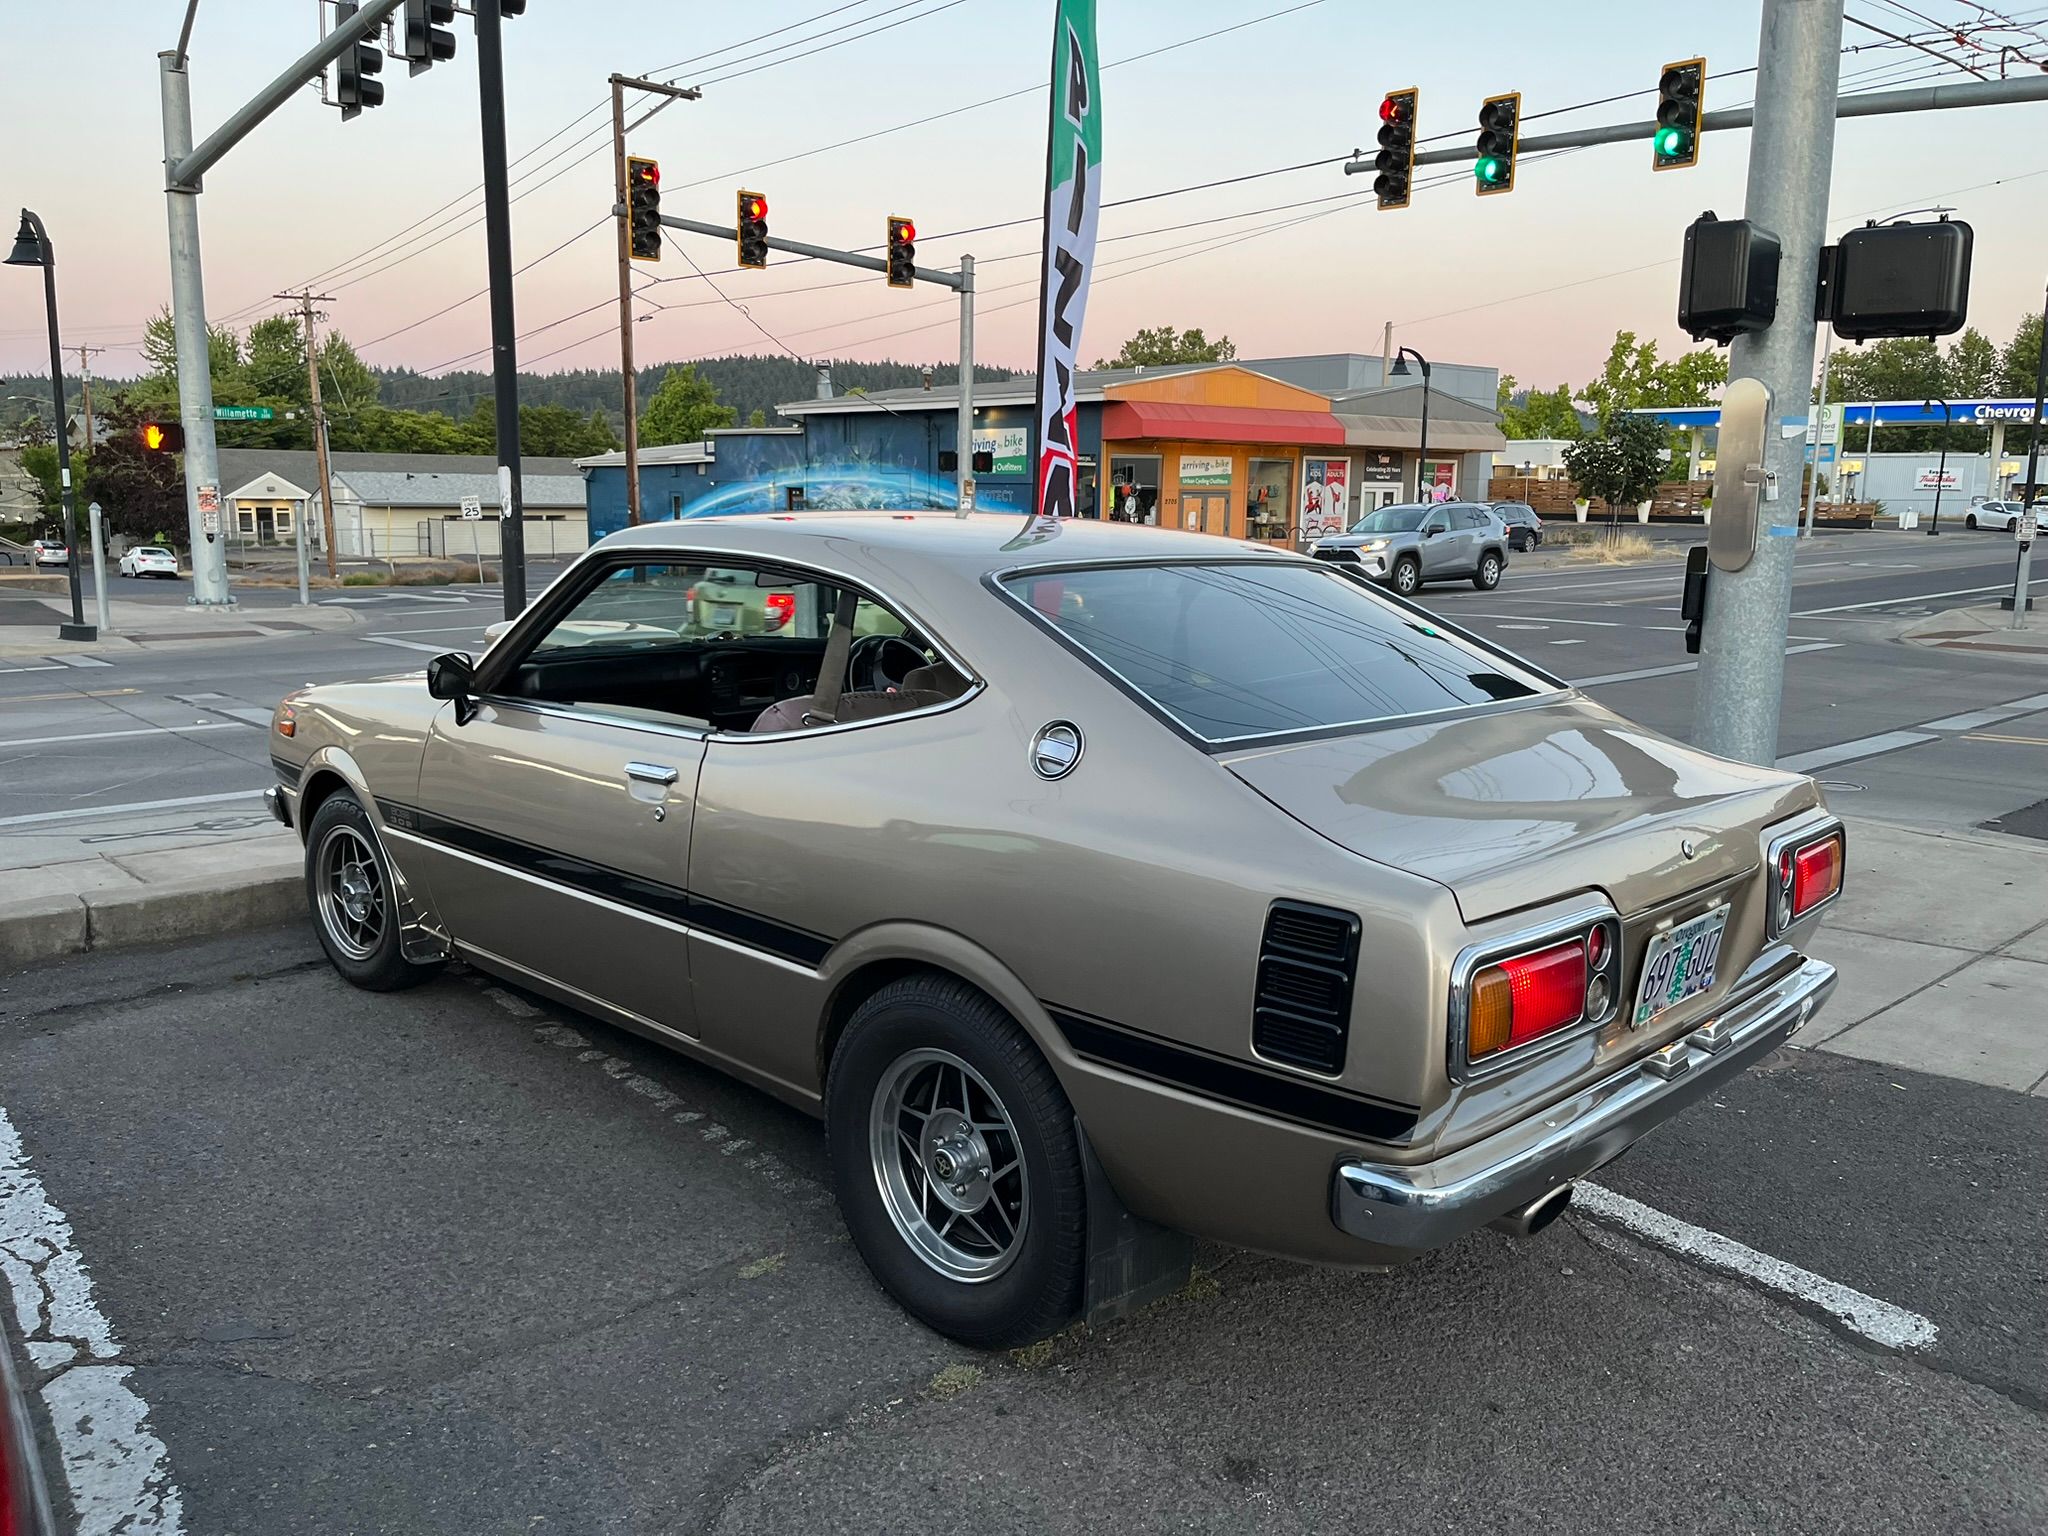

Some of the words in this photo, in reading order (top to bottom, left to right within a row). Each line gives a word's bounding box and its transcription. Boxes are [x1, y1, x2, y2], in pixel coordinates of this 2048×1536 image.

[216, 408, 257, 418] Willamette
[1004, 434, 1023, 448] bike
[996, 463, 1022, 471] Outfitters
[1182, 461, 1210, 472] arriving
[1215, 459, 1229, 468] bike
[464, 507, 480, 517] 25
[1675, 921, 1706, 942] Oregon
[1643, 944, 1683, 1004] 697
[1685, 926, 1724, 981] GUZ
